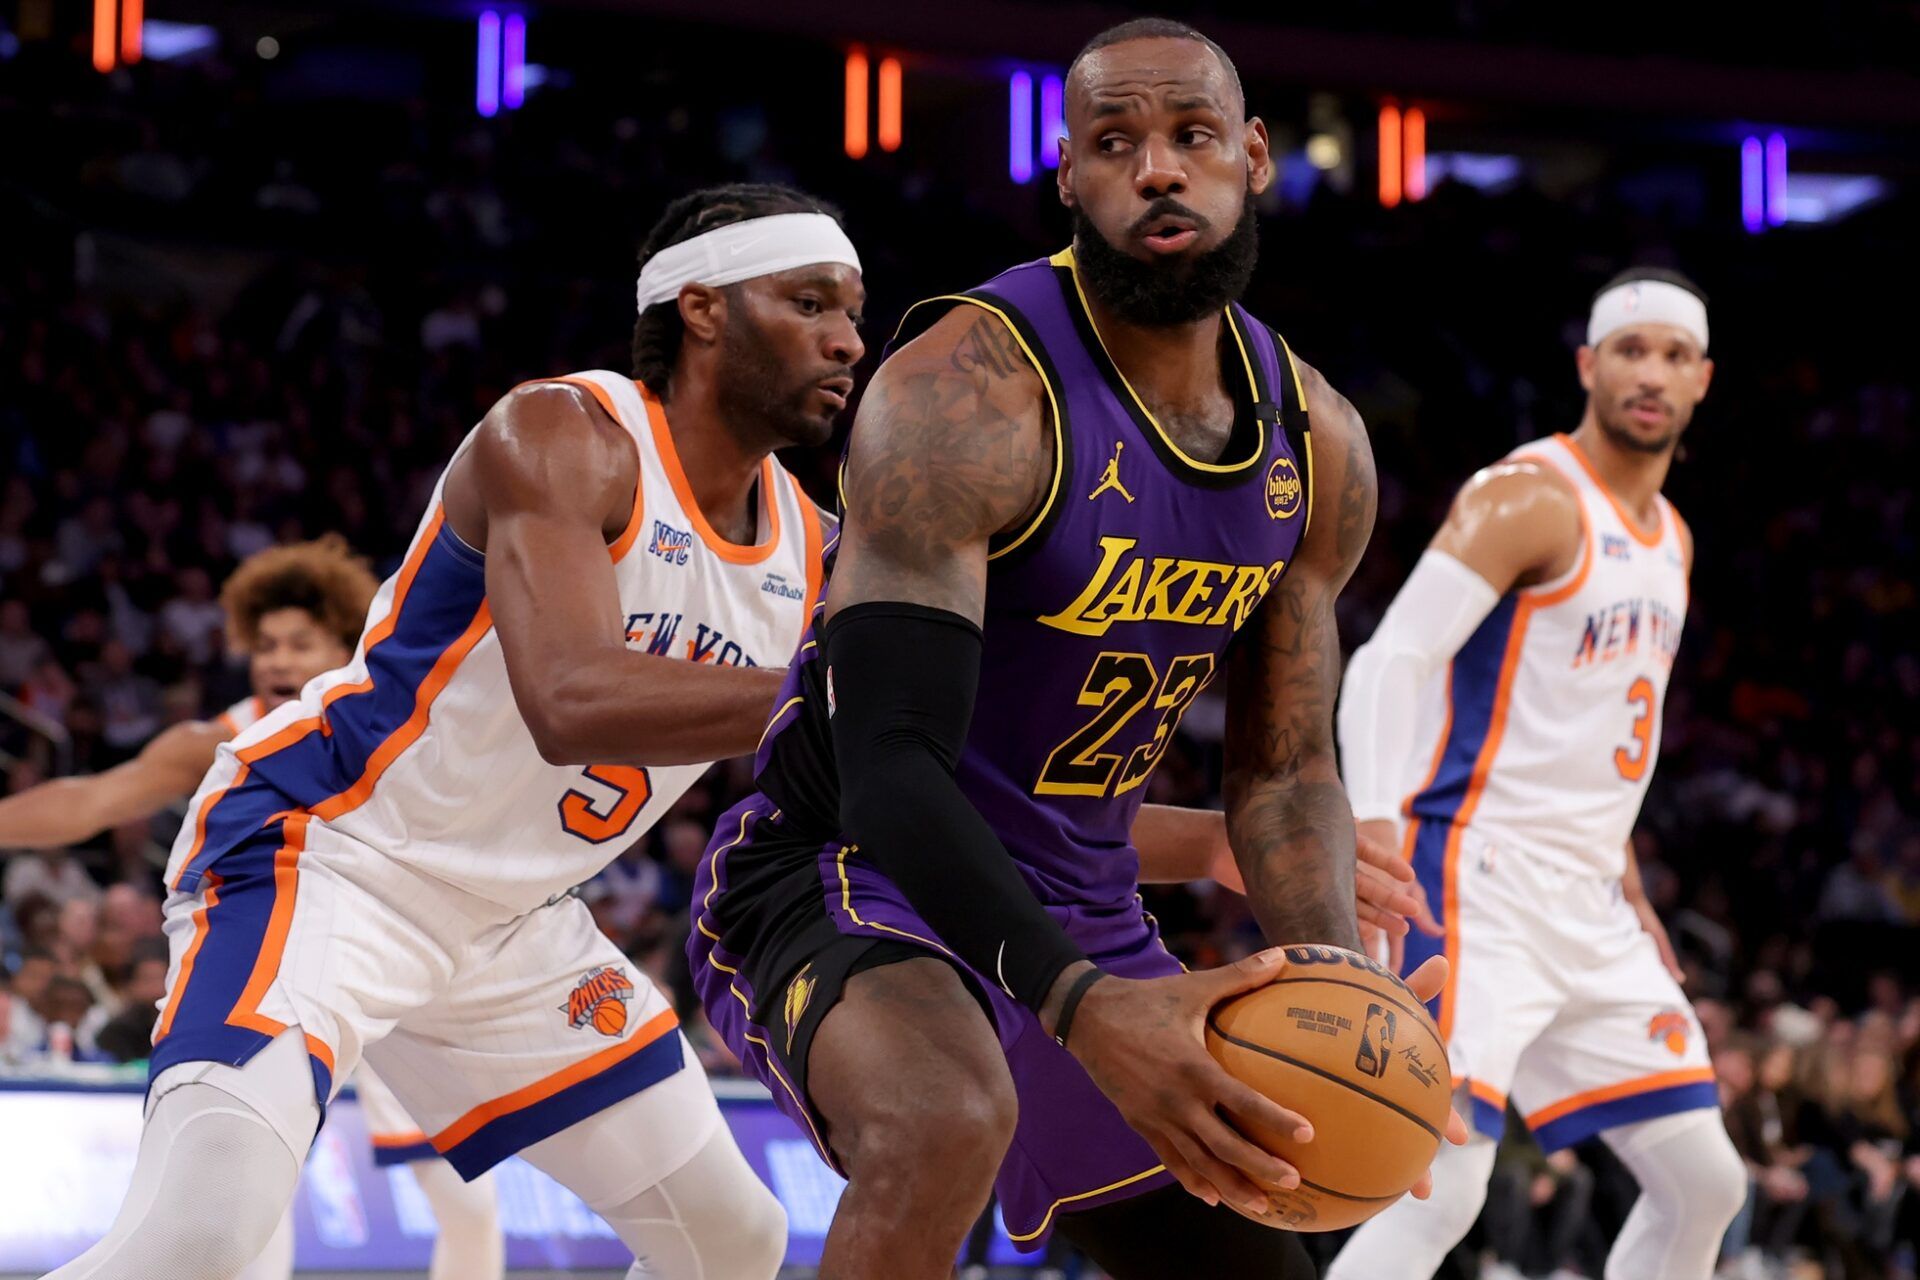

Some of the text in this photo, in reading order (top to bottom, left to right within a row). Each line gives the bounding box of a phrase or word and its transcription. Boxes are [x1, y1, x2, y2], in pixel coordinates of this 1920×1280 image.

[1269, 473, 1299, 500] bibigo
[648, 520, 692, 566] NYC
[761, 580, 777, 594] abu
[1037, 536, 1285, 637] LAKERS
[624, 613, 683, 657] EW
[1571, 597, 1642, 669] NEW
[1033, 652, 1215, 798] 23
[1613, 676, 1655, 782] 3
[568, 967, 634, 1027] KNICKS
[1287, 1007, 1352, 1031] OFFICIAL GAME BALL
